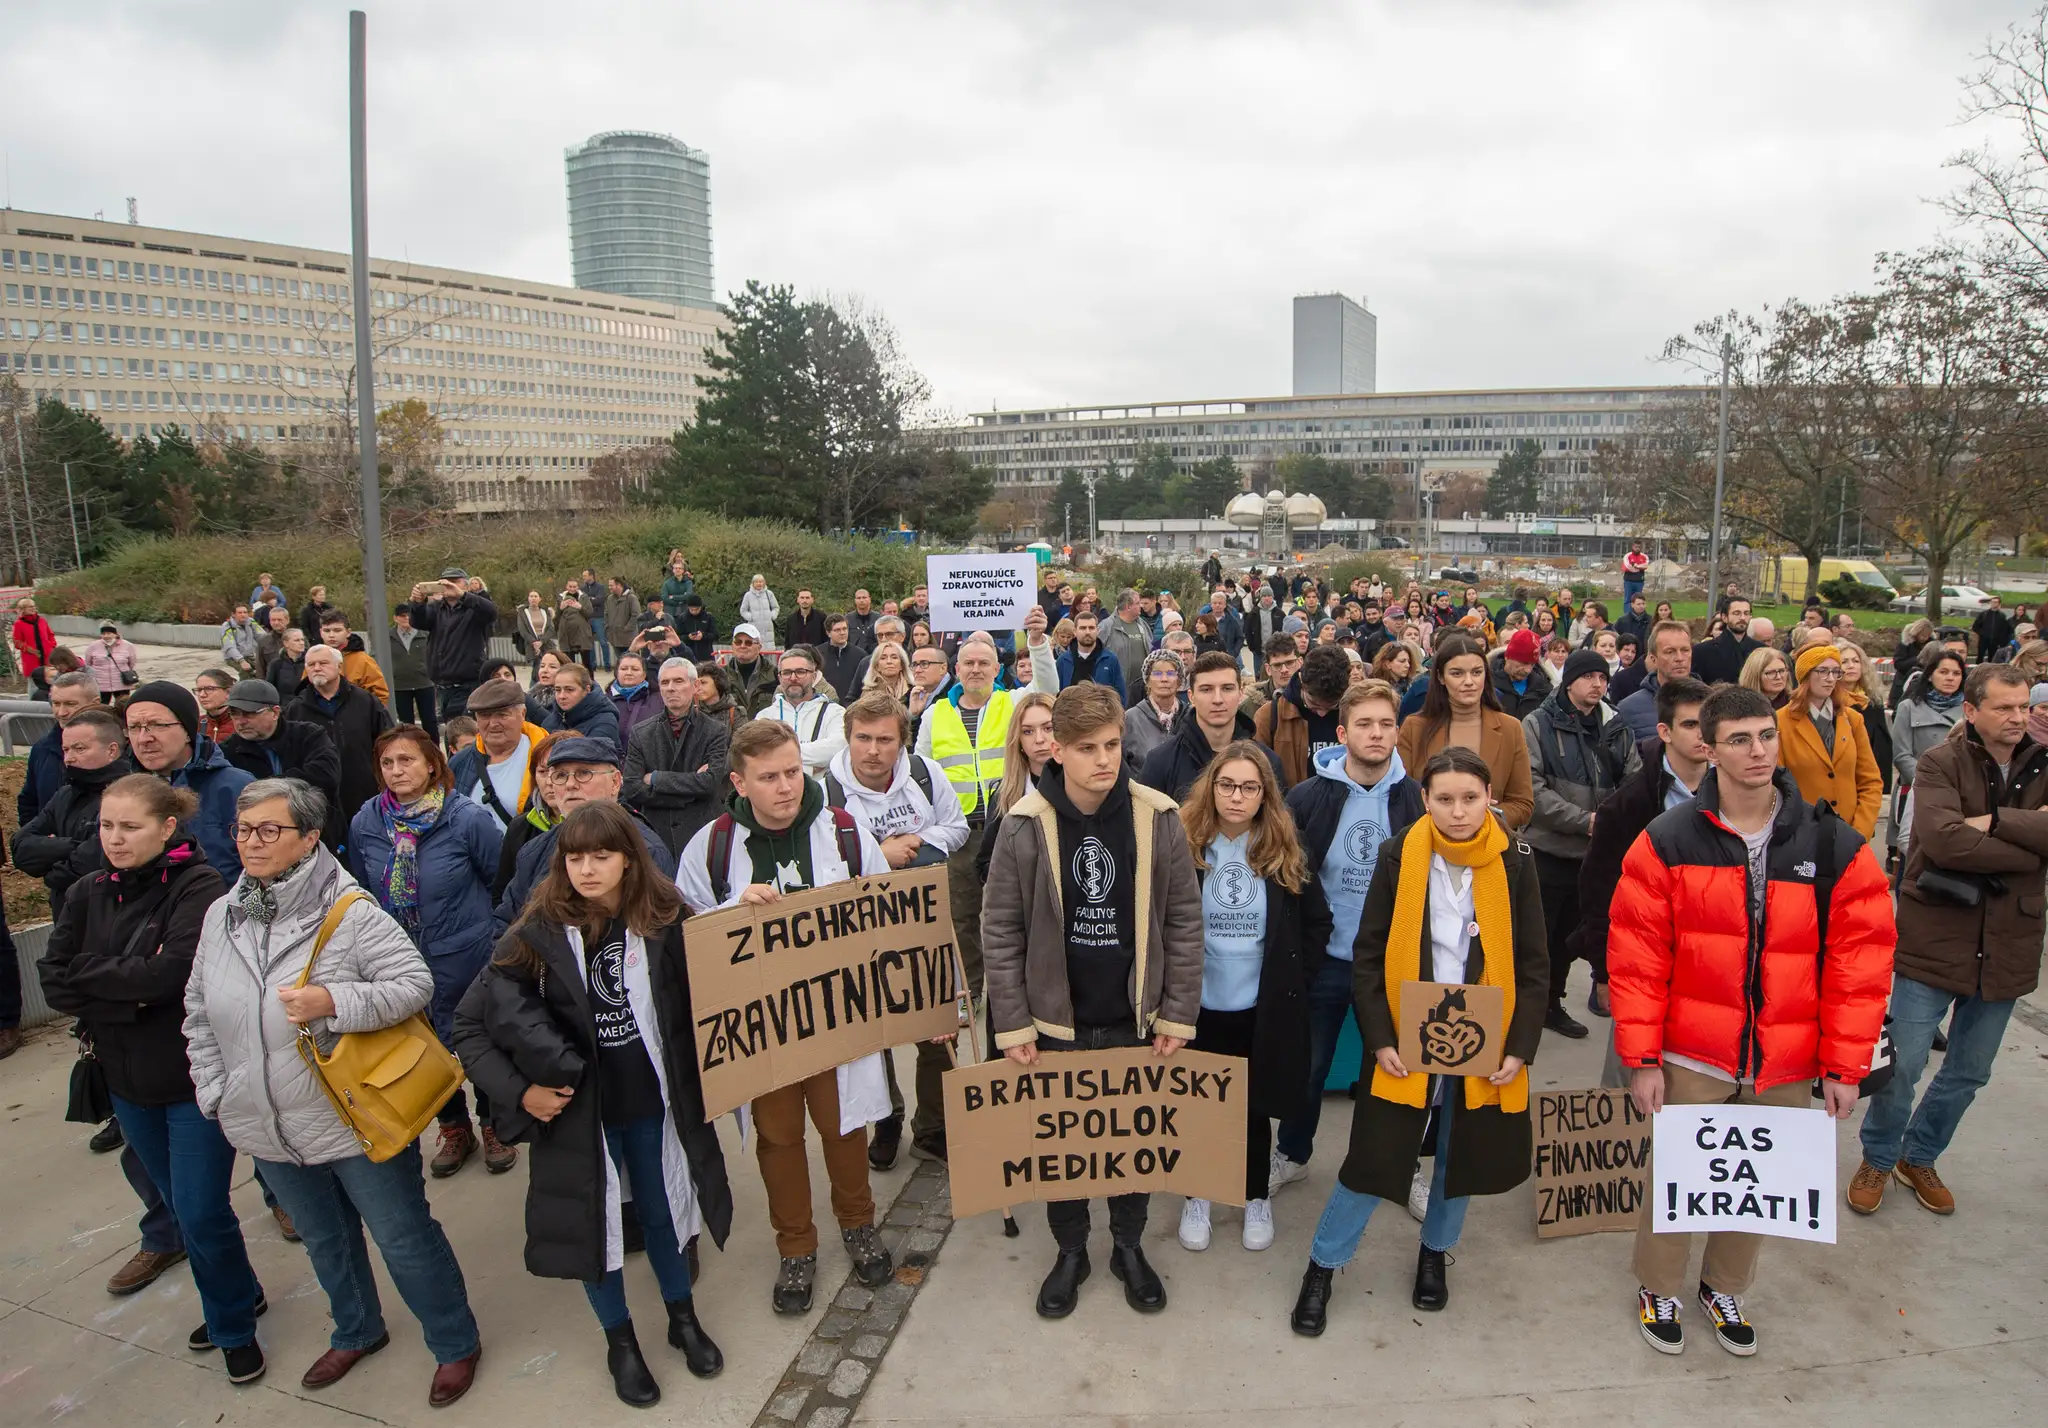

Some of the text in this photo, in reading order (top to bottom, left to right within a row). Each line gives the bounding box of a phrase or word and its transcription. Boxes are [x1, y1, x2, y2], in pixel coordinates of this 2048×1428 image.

[949, 568, 1016, 578] NEFUNGUJÚCE
[942, 578, 1023, 589] ZDRAVOTNÍCTVO
[953, 597, 1015, 608] NEBEZPEČNÁ
[963, 609, 1005, 618] KRAJINA
[1342, 868, 1374, 876] FACULTY
[1075, 906, 1117, 919] FAULTY OF
[1209, 912, 1260, 921] FACULTY OF
[727, 880, 938, 966] ZACHRÁŇME
[1210, 922, 1258, 930] MEDICINE
[697, 942, 957, 1072] ZDRAVOTNÍCTVO
[964, 1064, 1232, 1112] BRATISLAVSKÝ
[1035, 1104, 1178, 1141] SPOLOK
[1539, 1089, 1613, 1138] PREČO
[1696, 1118, 1773, 1152] ČAS
[1003, 1146, 1182, 1188] MEDIKOV
[1709, 1158, 1760, 1184] SA
